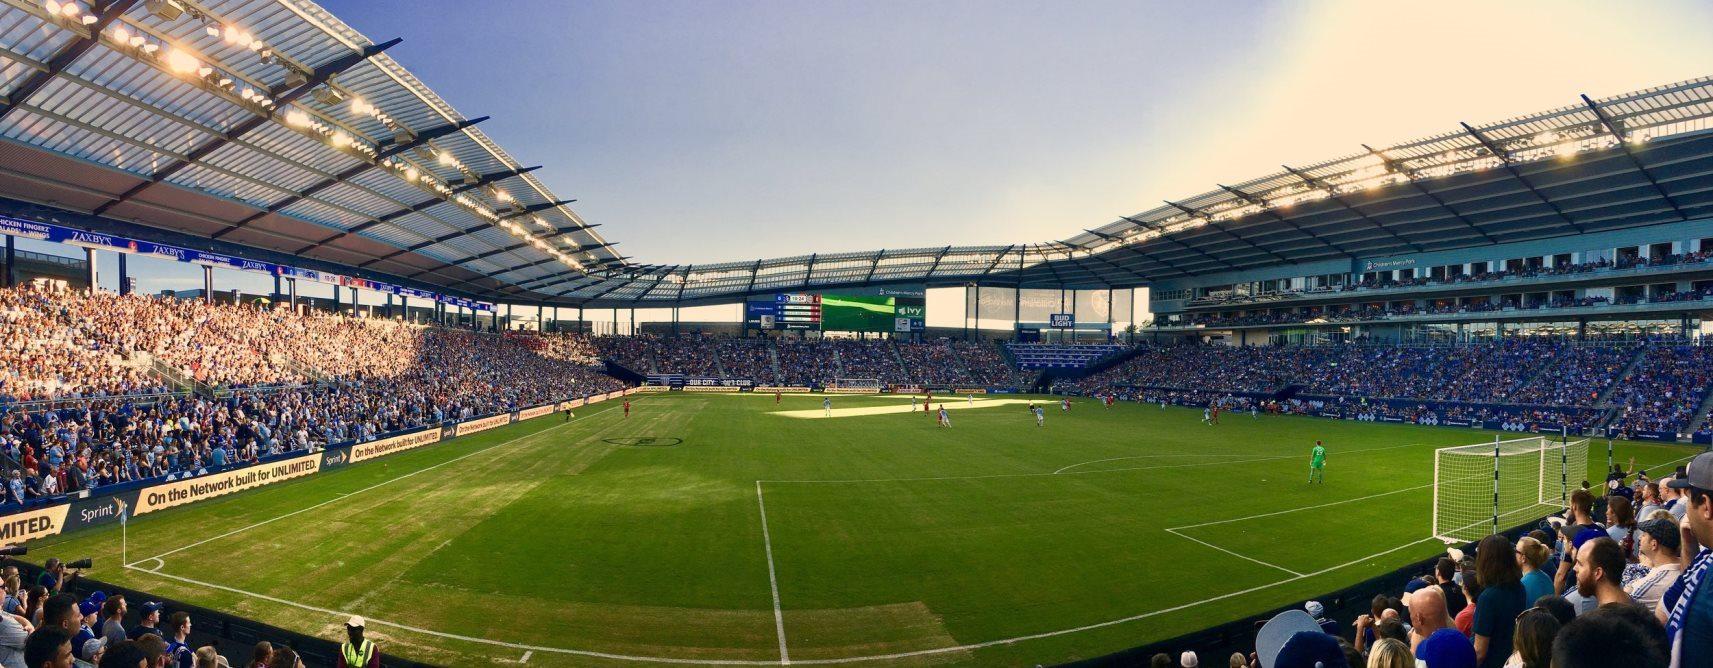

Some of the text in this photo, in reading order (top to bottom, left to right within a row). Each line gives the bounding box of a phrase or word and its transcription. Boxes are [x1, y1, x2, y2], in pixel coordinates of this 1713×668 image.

[72, 231, 112, 247] ZAXBY'S
[153, 245, 185, 260] ZAXBY'S
[242, 260, 267, 271] ZAXBY'S
[355, 448, 364, 458] On
[364, 446, 374, 455] the
[375, 442, 396, 454] Network
[397, 439, 407, 448] built
[326, 455, 341, 466] Sprint
[147, 460, 317, 506] On the Network built for UNLIMITED.
[81, 503, 113, 523] Sprint
